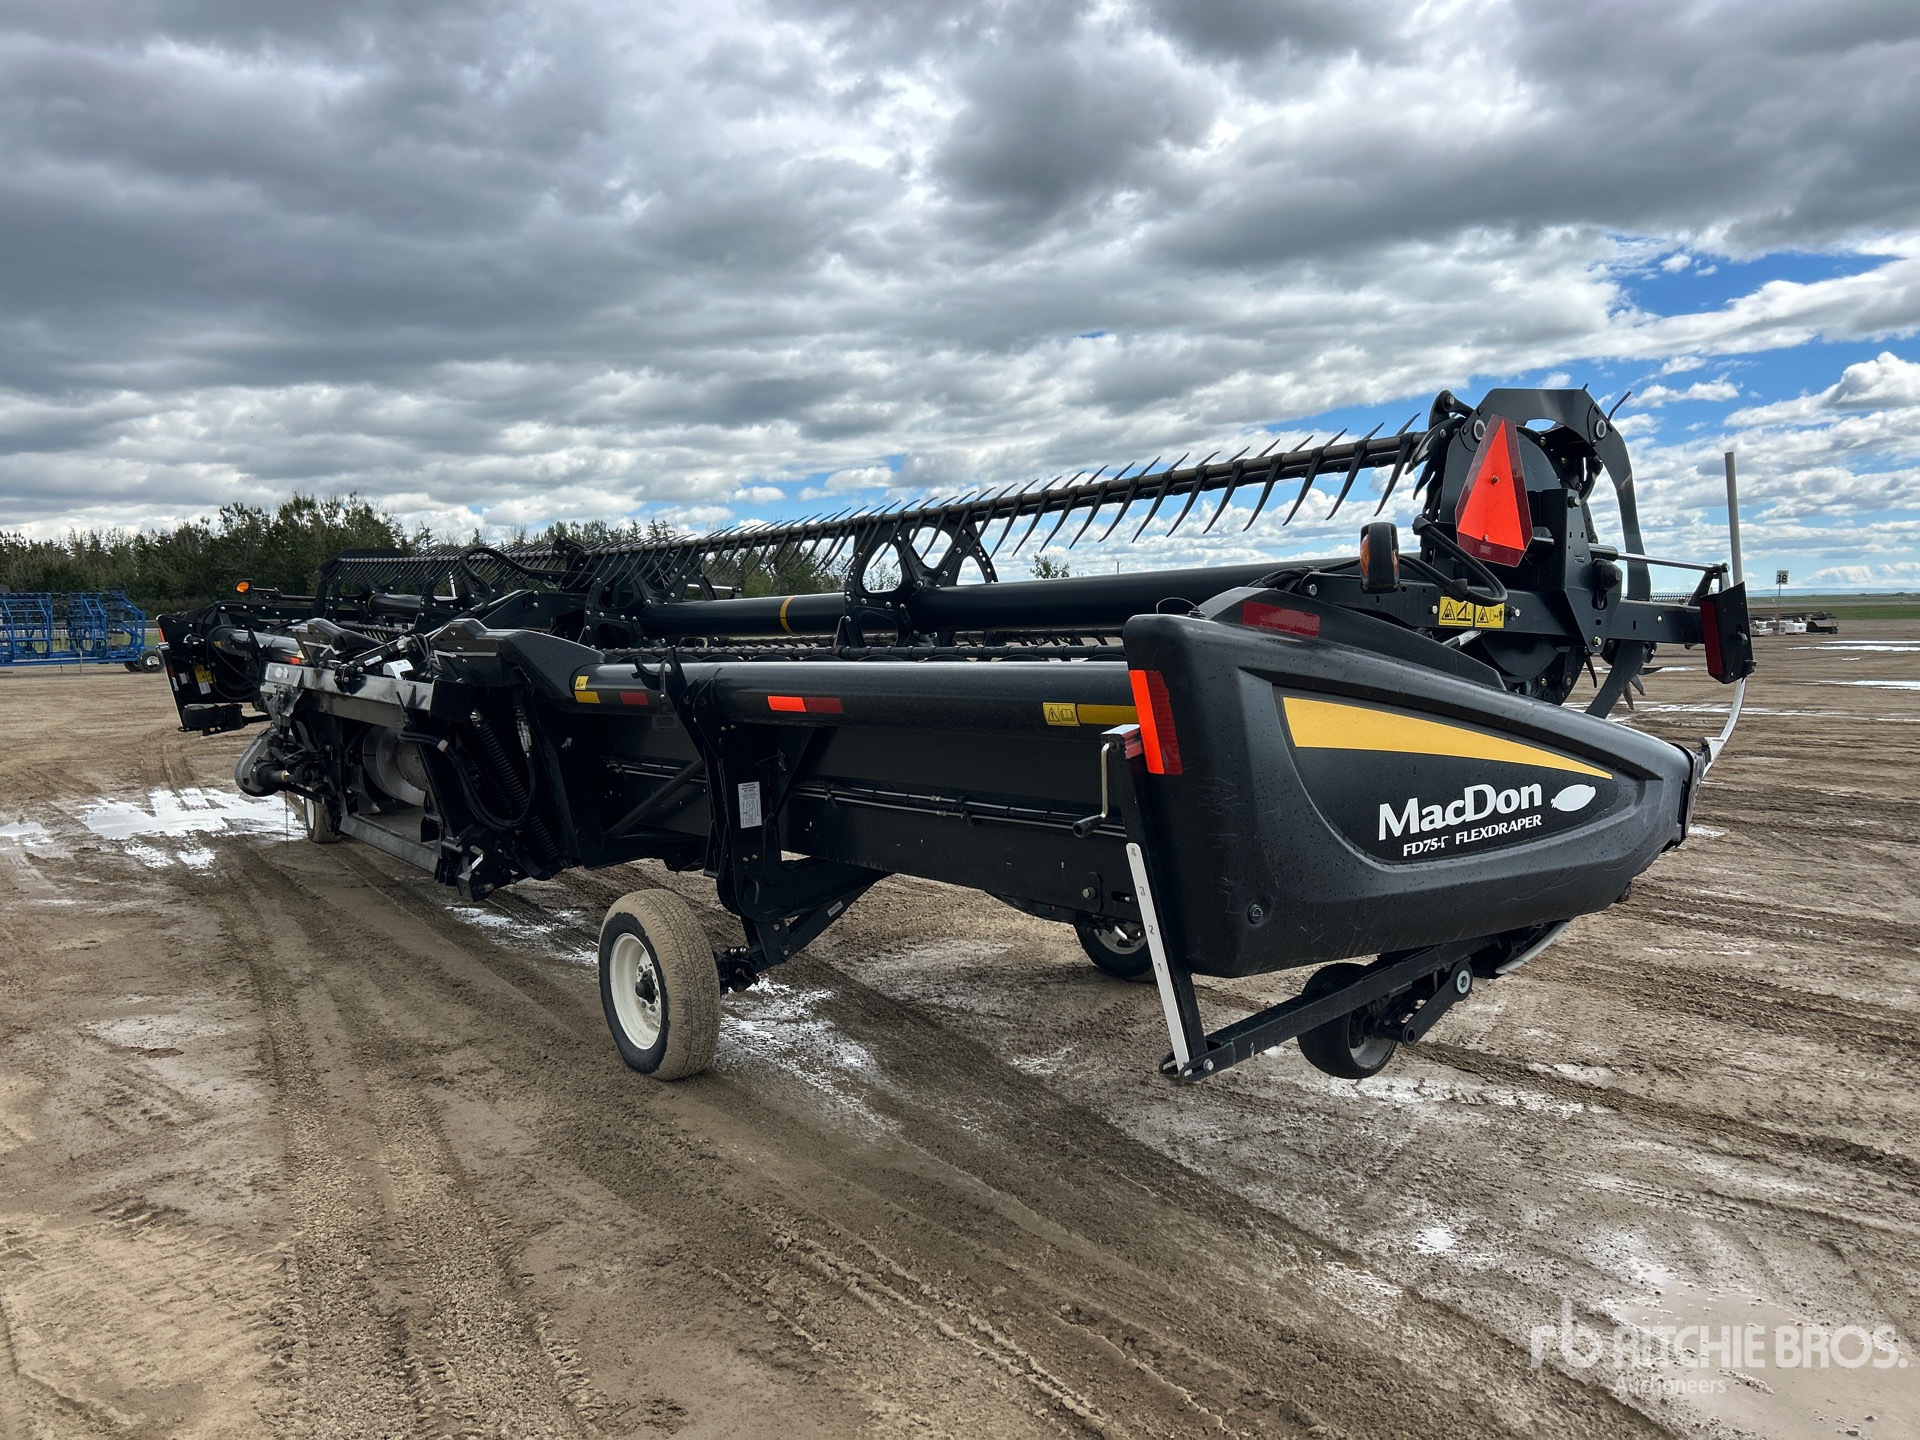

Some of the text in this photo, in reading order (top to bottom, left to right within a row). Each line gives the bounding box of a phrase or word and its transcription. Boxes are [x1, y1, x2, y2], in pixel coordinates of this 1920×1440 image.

[1378, 783, 1543, 841] MacDon
[1455, 814, 1543, 845] FLEXDRAPER
[1139, 885, 1146, 897] 3
[1148, 924, 1155, 935] 2
